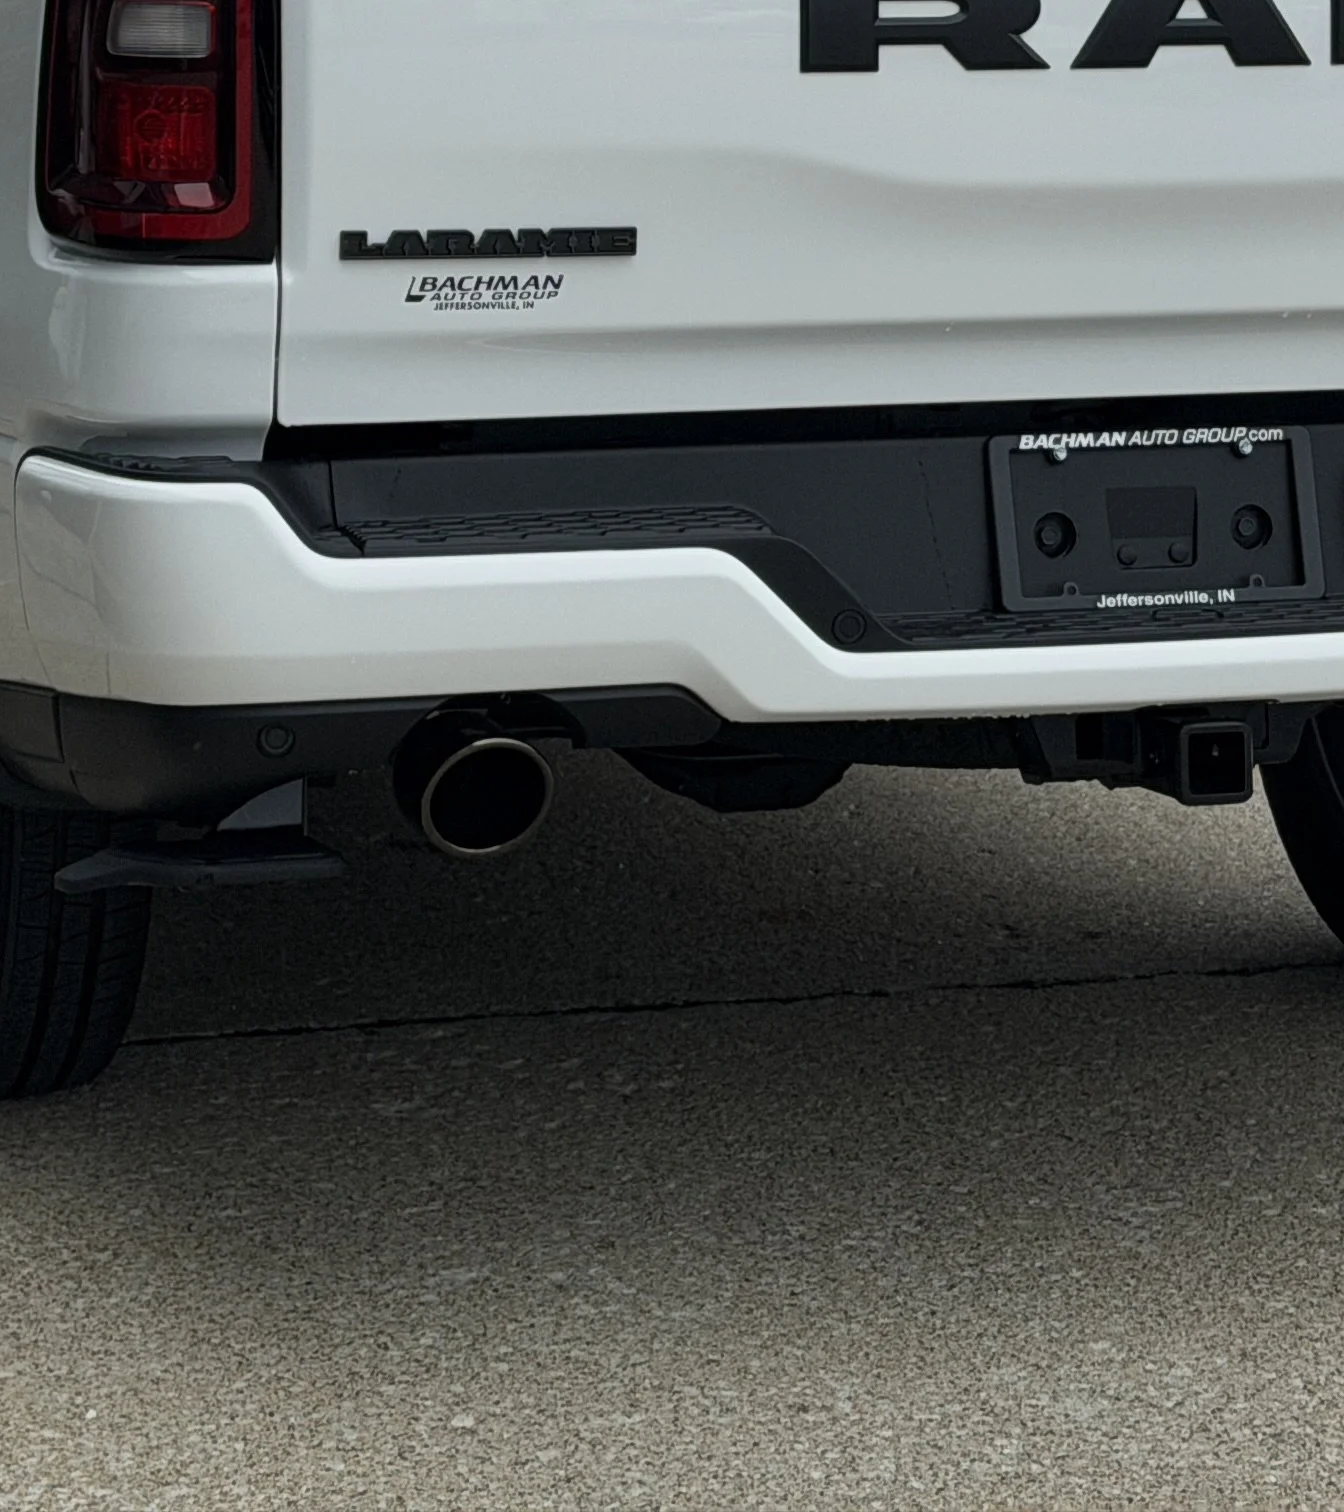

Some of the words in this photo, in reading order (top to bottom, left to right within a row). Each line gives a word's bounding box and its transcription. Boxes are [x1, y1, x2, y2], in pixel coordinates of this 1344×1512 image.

[339, 227, 637, 260] LARAMIE
[418, 274, 564, 292] BACHMAN
[430, 292, 482, 301] AUTO
[492, 291, 559, 300] GROUP
[434, 301, 520, 311] JEFFERSONVILLE,
[522, 300, 535, 309] IN
[1018, 432, 1126, 450] BACHMAN
[1127, 429, 1179, 446] AUTO
[1096, 590, 1214, 608] Jeffersonville,
[1217, 588, 1236, 603] IN
